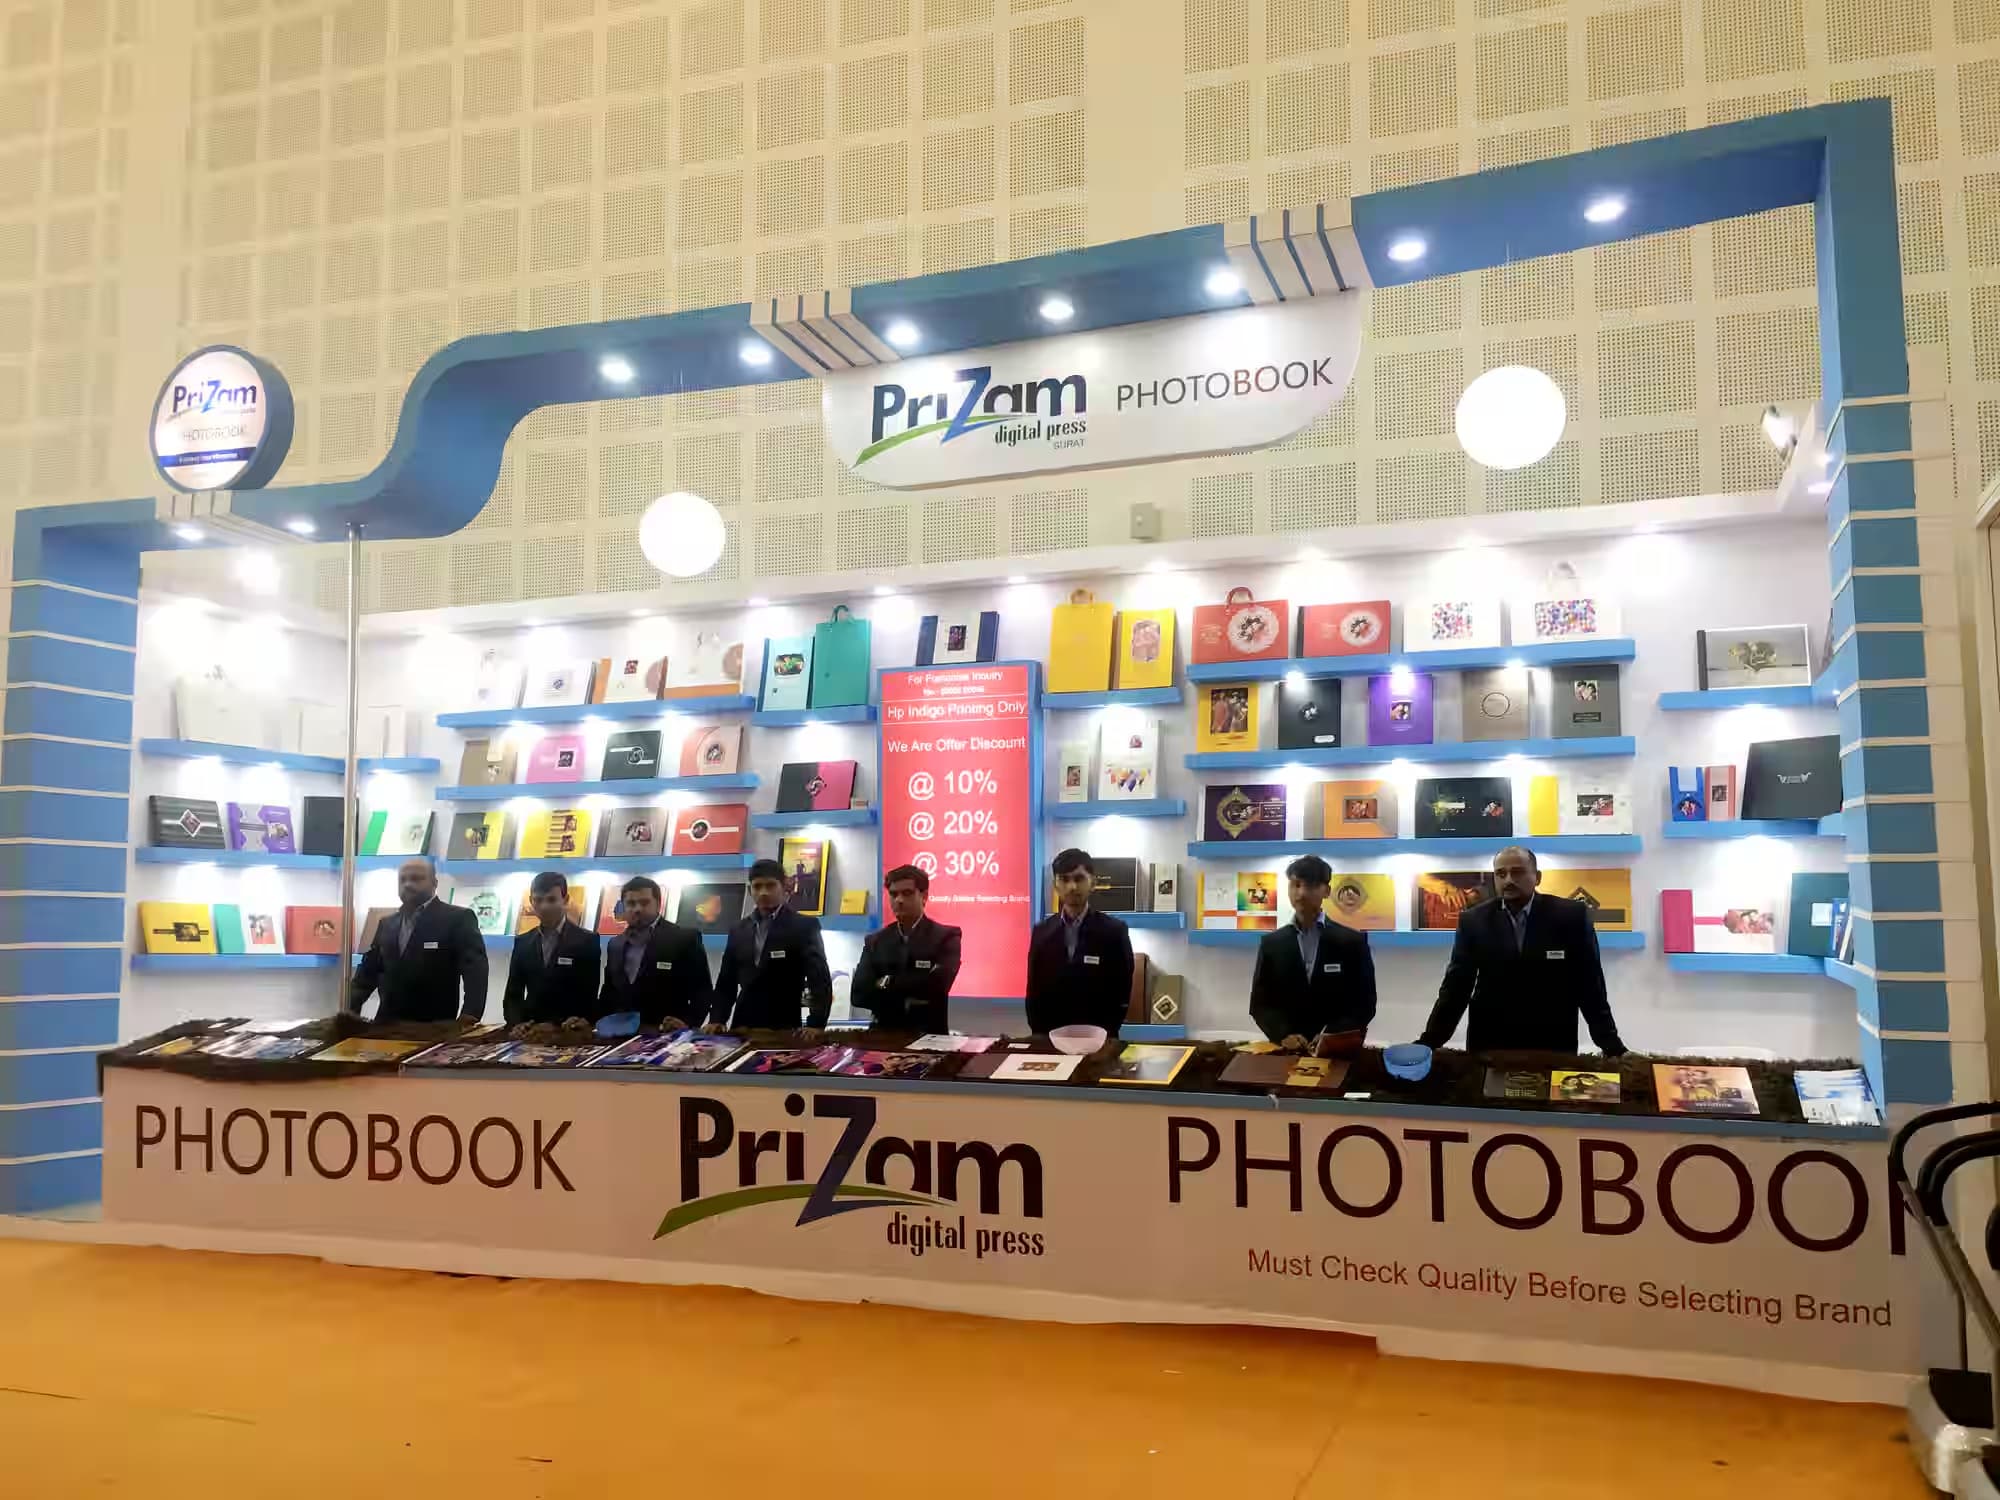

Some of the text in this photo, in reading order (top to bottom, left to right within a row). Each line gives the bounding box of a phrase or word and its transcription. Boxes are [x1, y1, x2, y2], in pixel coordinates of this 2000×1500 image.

[172, 379, 257, 413] PriZam
[1117, 356, 1334, 411] PHOTOBOOK
[871, 366, 1087, 445] PriZam
[995, 419, 1086, 447] digital press
[1053, 438, 1085, 450] SURAT
[908, 674, 923, 684] For
[887, 701, 1026, 720] Hp Indigo Printing Only
[888, 736, 1026, 753] We Are Offer Discount
[908, 769, 998, 801] @ 10%
[908, 810, 998, 841] @ 20%
[911, 850, 1000, 881] @ 30%
[136, 1104, 576, 1192] PHOTOBOOK
[679, 1093, 1044, 1227] PriZam
[886, 1211, 1045, 1259] digital press
[1247, 1248, 1893, 1327] Must Check Quality Before Selecting Brand
